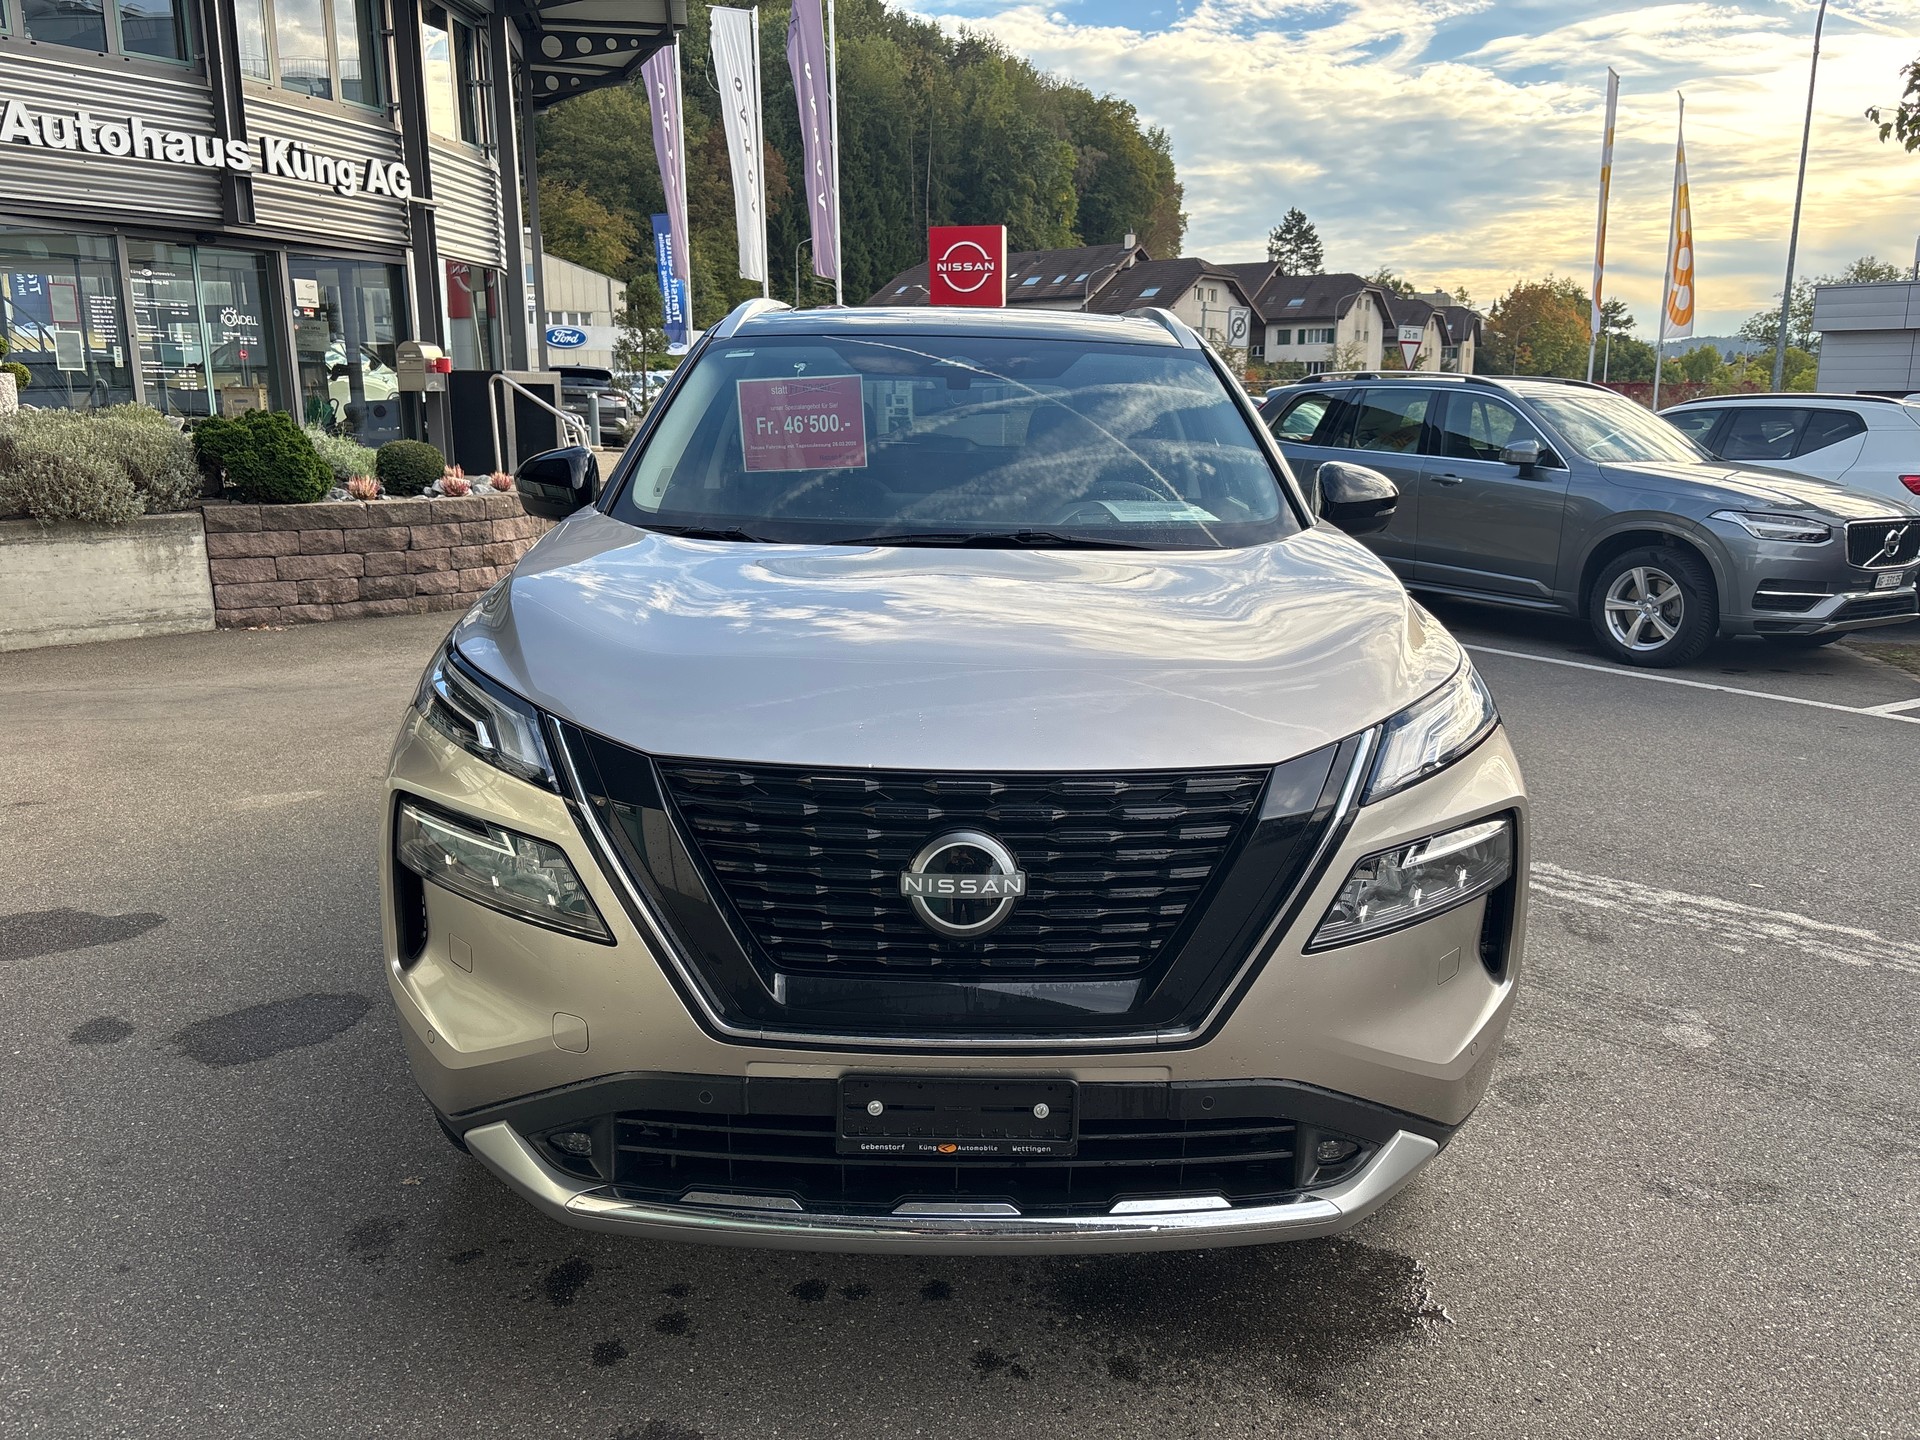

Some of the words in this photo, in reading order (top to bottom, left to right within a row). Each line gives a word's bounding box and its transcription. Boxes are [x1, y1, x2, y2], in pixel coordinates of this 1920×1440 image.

[0, 99, 252, 171] Autohaus
[261, 136, 358, 197] Küng
[365, 158, 412, 199] AG
[937, 262, 994, 271] NISSAN
[551, 329, 579, 344] Ford
[1404, 330, 1411, 339] 25
[770, 385, 788, 395] statt
[784, 402, 820, 412] Spezialangebot
[756, 417, 778, 435] Fr.
[905, 876, 1022, 894] NISSAN
[861, 1143, 905, 1151] Gebenstorf
[918, 1143, 937, 1152] Küng
[957, 1143, 998, 1151] Automobile
[1012, 1145, 1051, 1153] Wettingen
